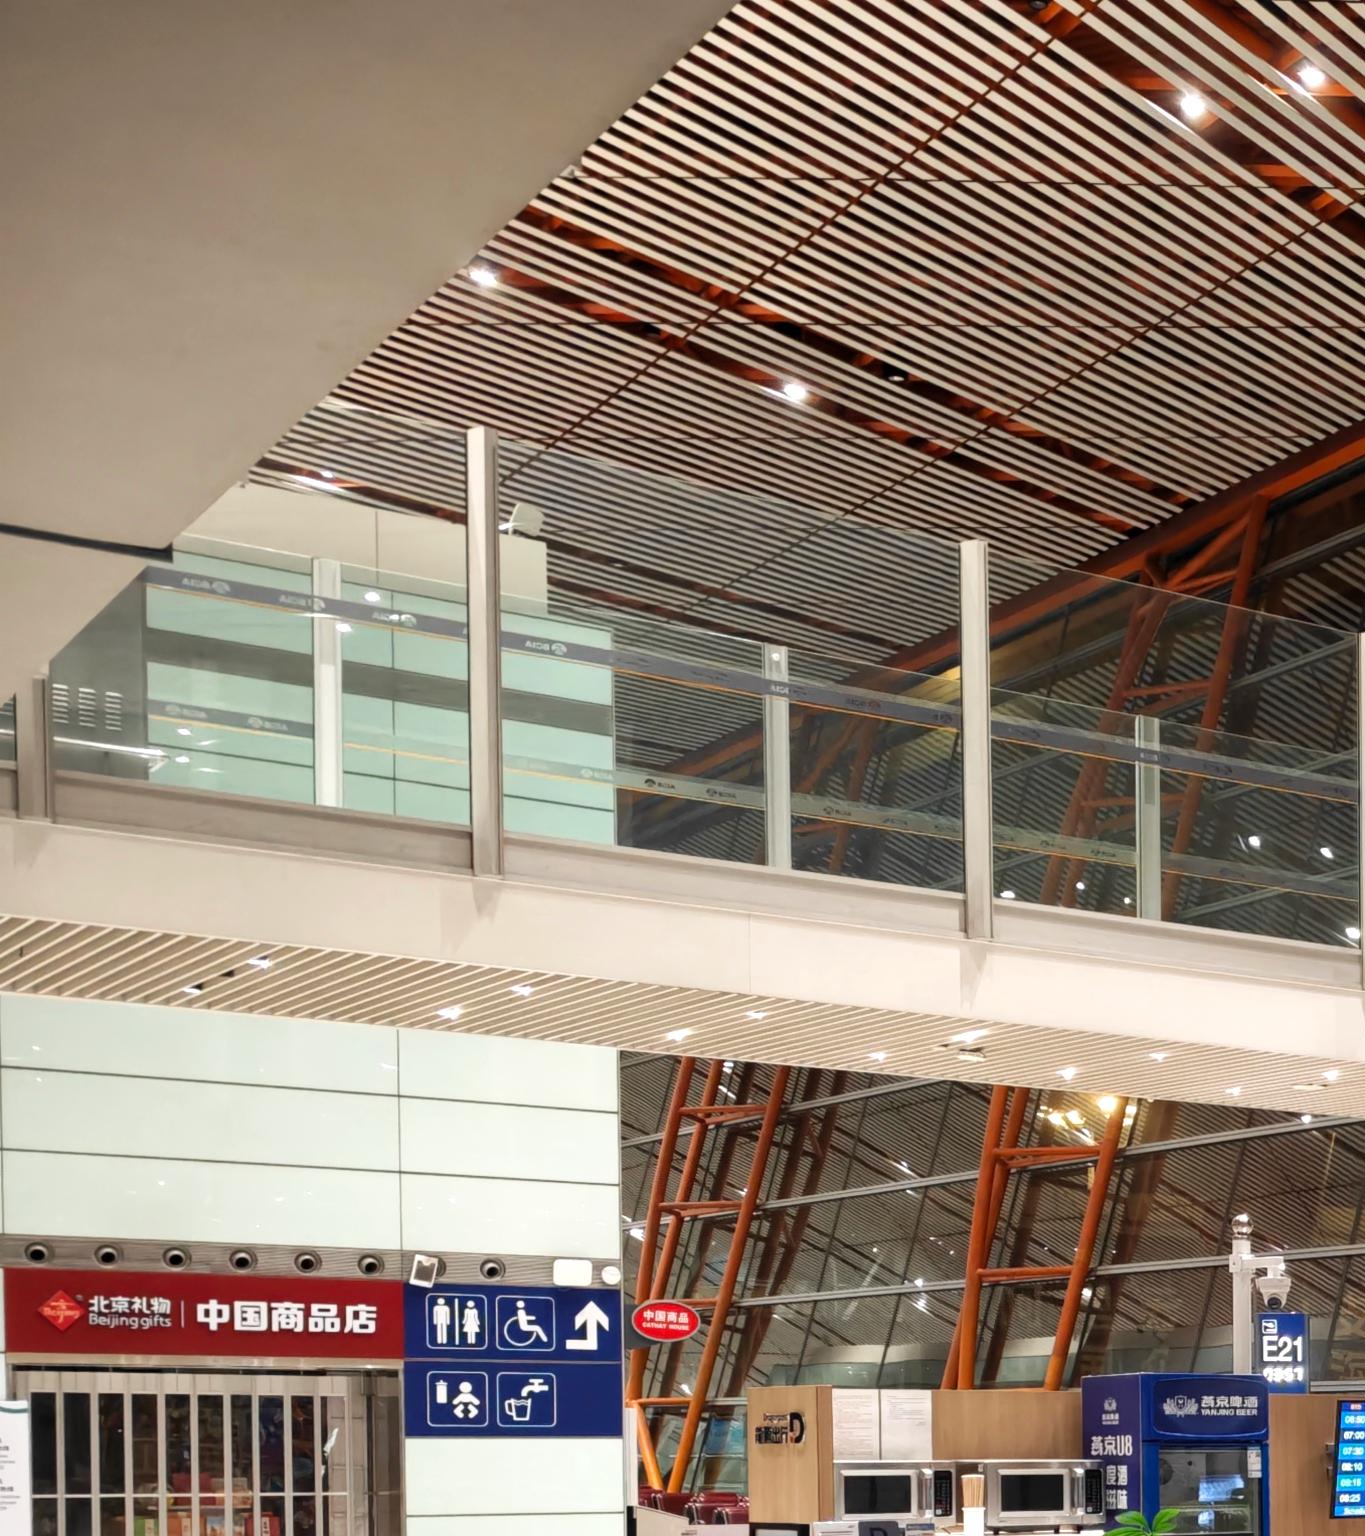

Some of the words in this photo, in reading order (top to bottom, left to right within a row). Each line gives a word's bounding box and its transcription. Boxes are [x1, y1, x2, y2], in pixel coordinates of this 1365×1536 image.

[88, 1295, 172, 1314] 北京礼物
[196, 1299, 378, 1335] 中国商品店
[643, 1309, 689, 1324] 中国商品
[641, 1321, 666, 1330] CATHAY
[668, 1323, 690, 1331] HOUSE
[1262, 1335, 1303, 1362] E21
[1201, 1395, 1258, 1409] 燕京啤酒
[1200, 1408, 1235, 1417] YANJING
[1236, 1408, 1258, 1417] BEER
[1091, 1435, 1133, 1456] 燕京U8
